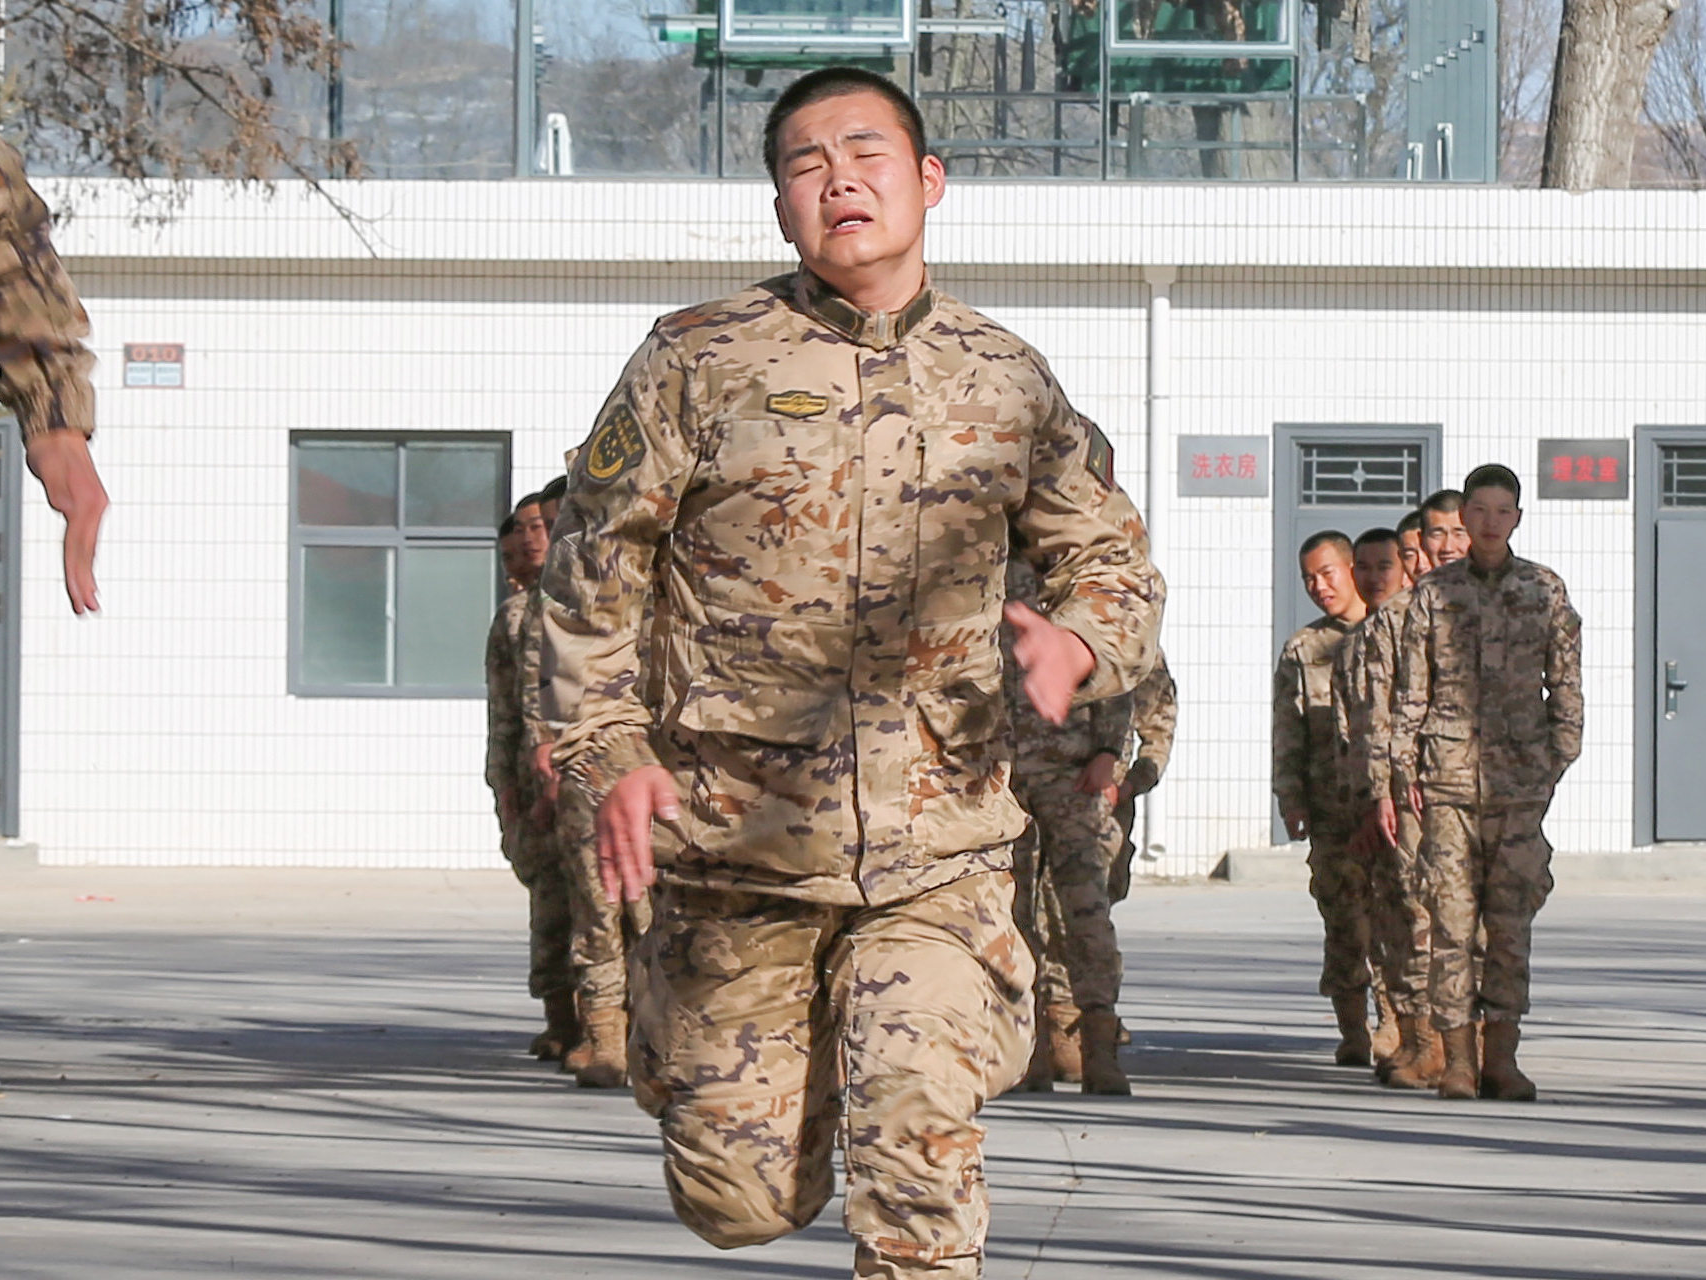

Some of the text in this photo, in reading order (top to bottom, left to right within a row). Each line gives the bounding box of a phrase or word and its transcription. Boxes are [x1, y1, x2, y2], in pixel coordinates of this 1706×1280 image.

[1191, 452, 1257, 479] 洗衣房
[1551, 455, 1619, 483] 理发室
